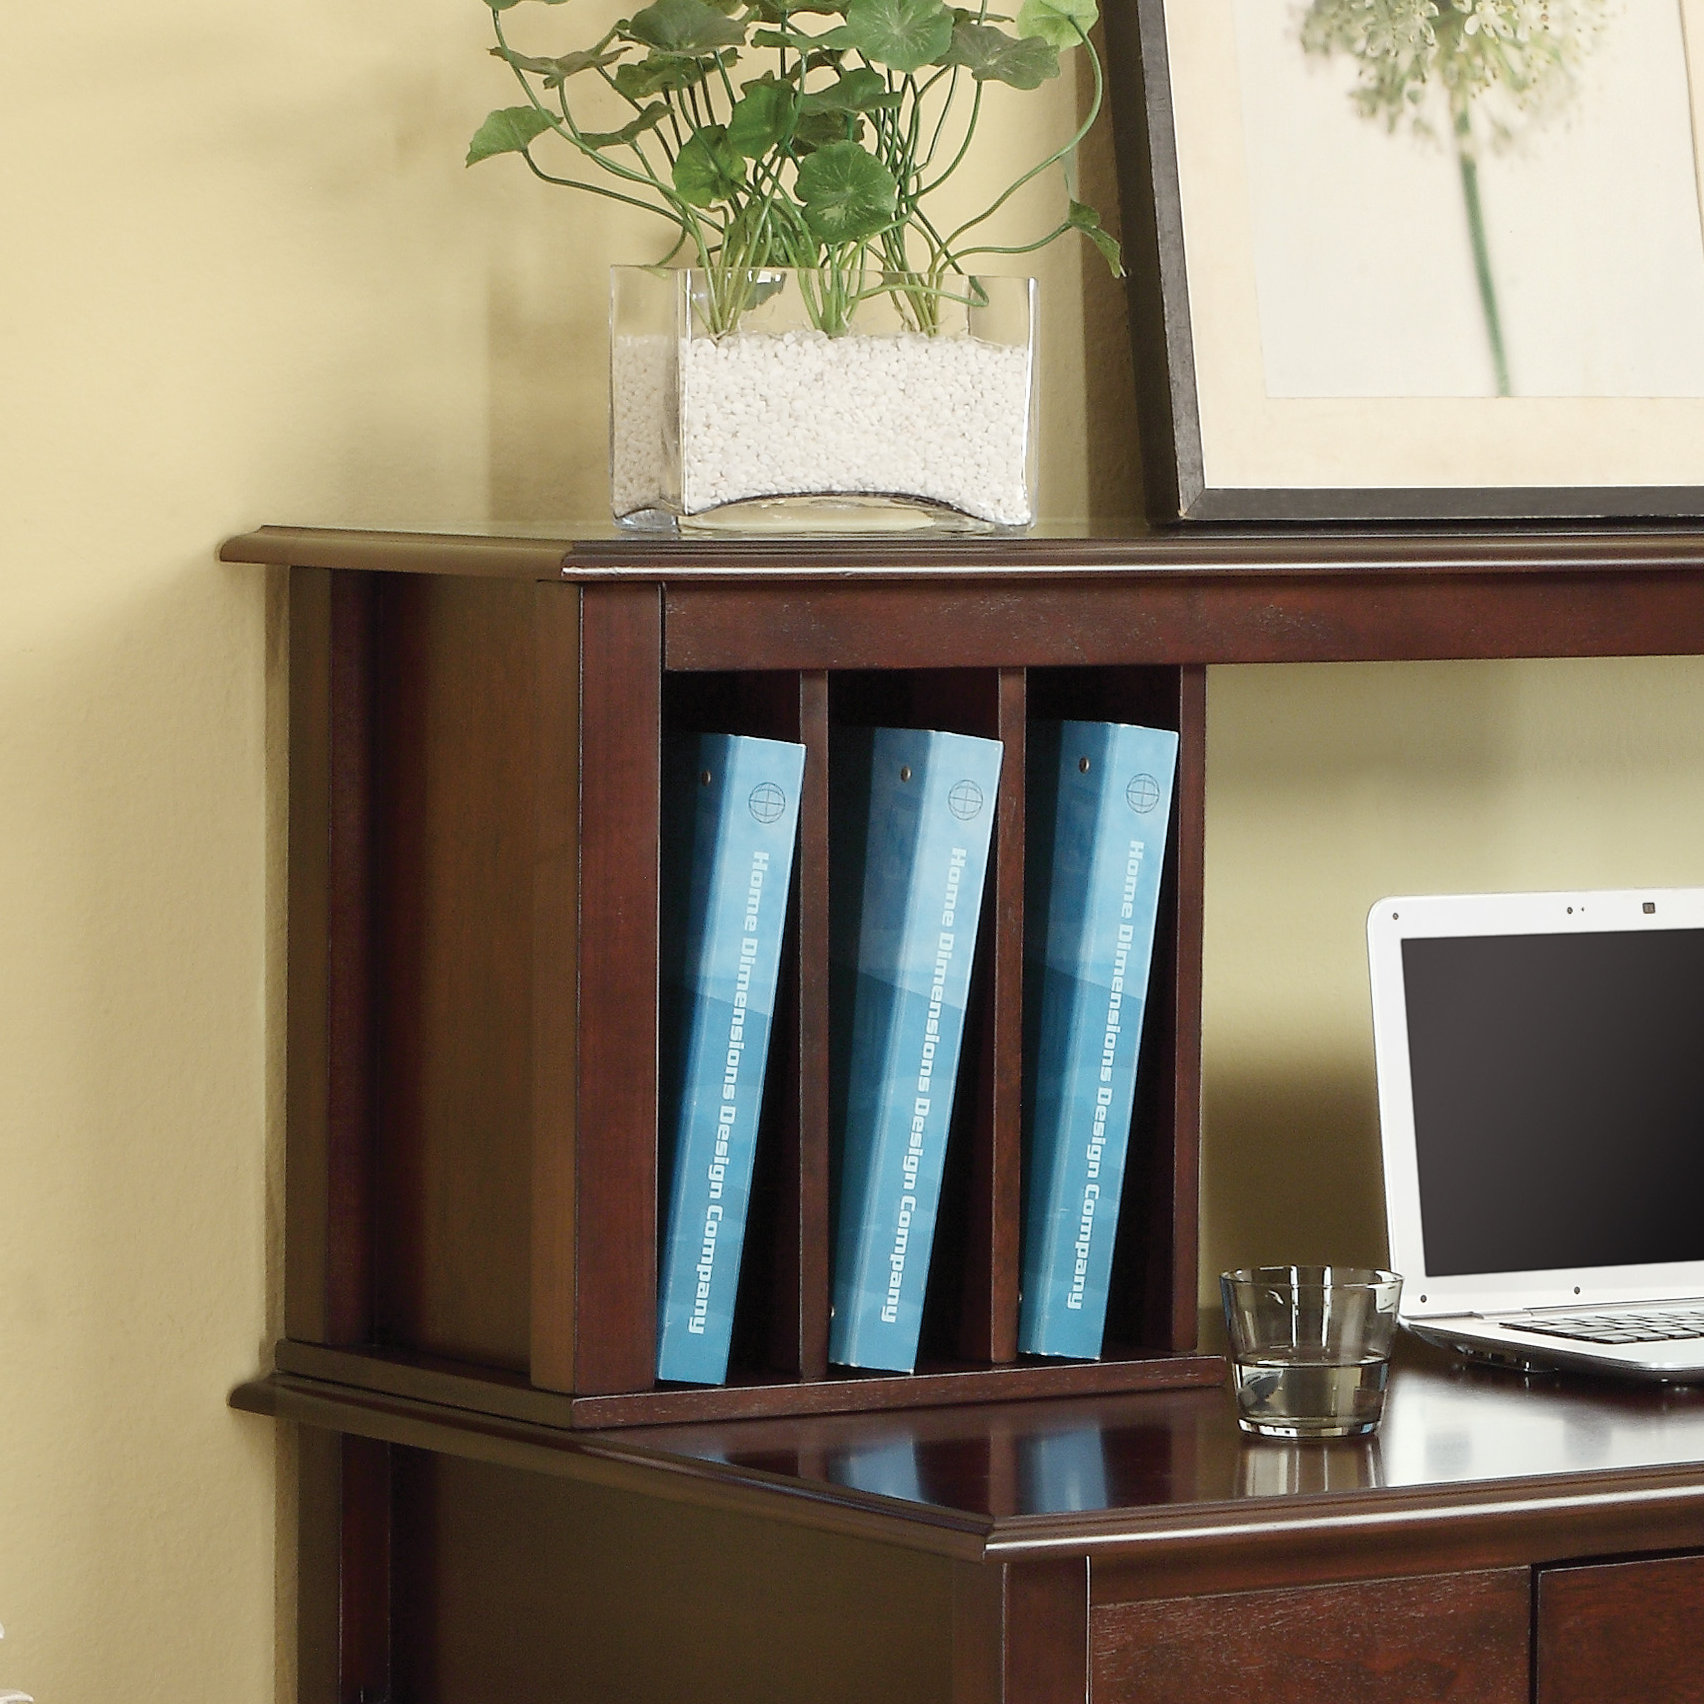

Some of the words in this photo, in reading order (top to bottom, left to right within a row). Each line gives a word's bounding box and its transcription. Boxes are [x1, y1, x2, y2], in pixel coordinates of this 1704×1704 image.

[744, 851, 770, 933] Home
[942, 847, 967, 928] Home
[1121, 840, 1145, 919] Home
[722, 937, 758, 1100] Dimensions
[917, 932, 955, 1092] Dimensions
[1099, 924, 1134, 1083] Dimensions
[708, 1105, 737, 1200] Design
[903, 1097, 931, 1191] Design
[1087, 1087, 1113, 1179] Design
[688, 1204, 724, 1335] Company
[881, 1195, 917, 1323] Company
[1067, 1184, 1100, 1311] Company
